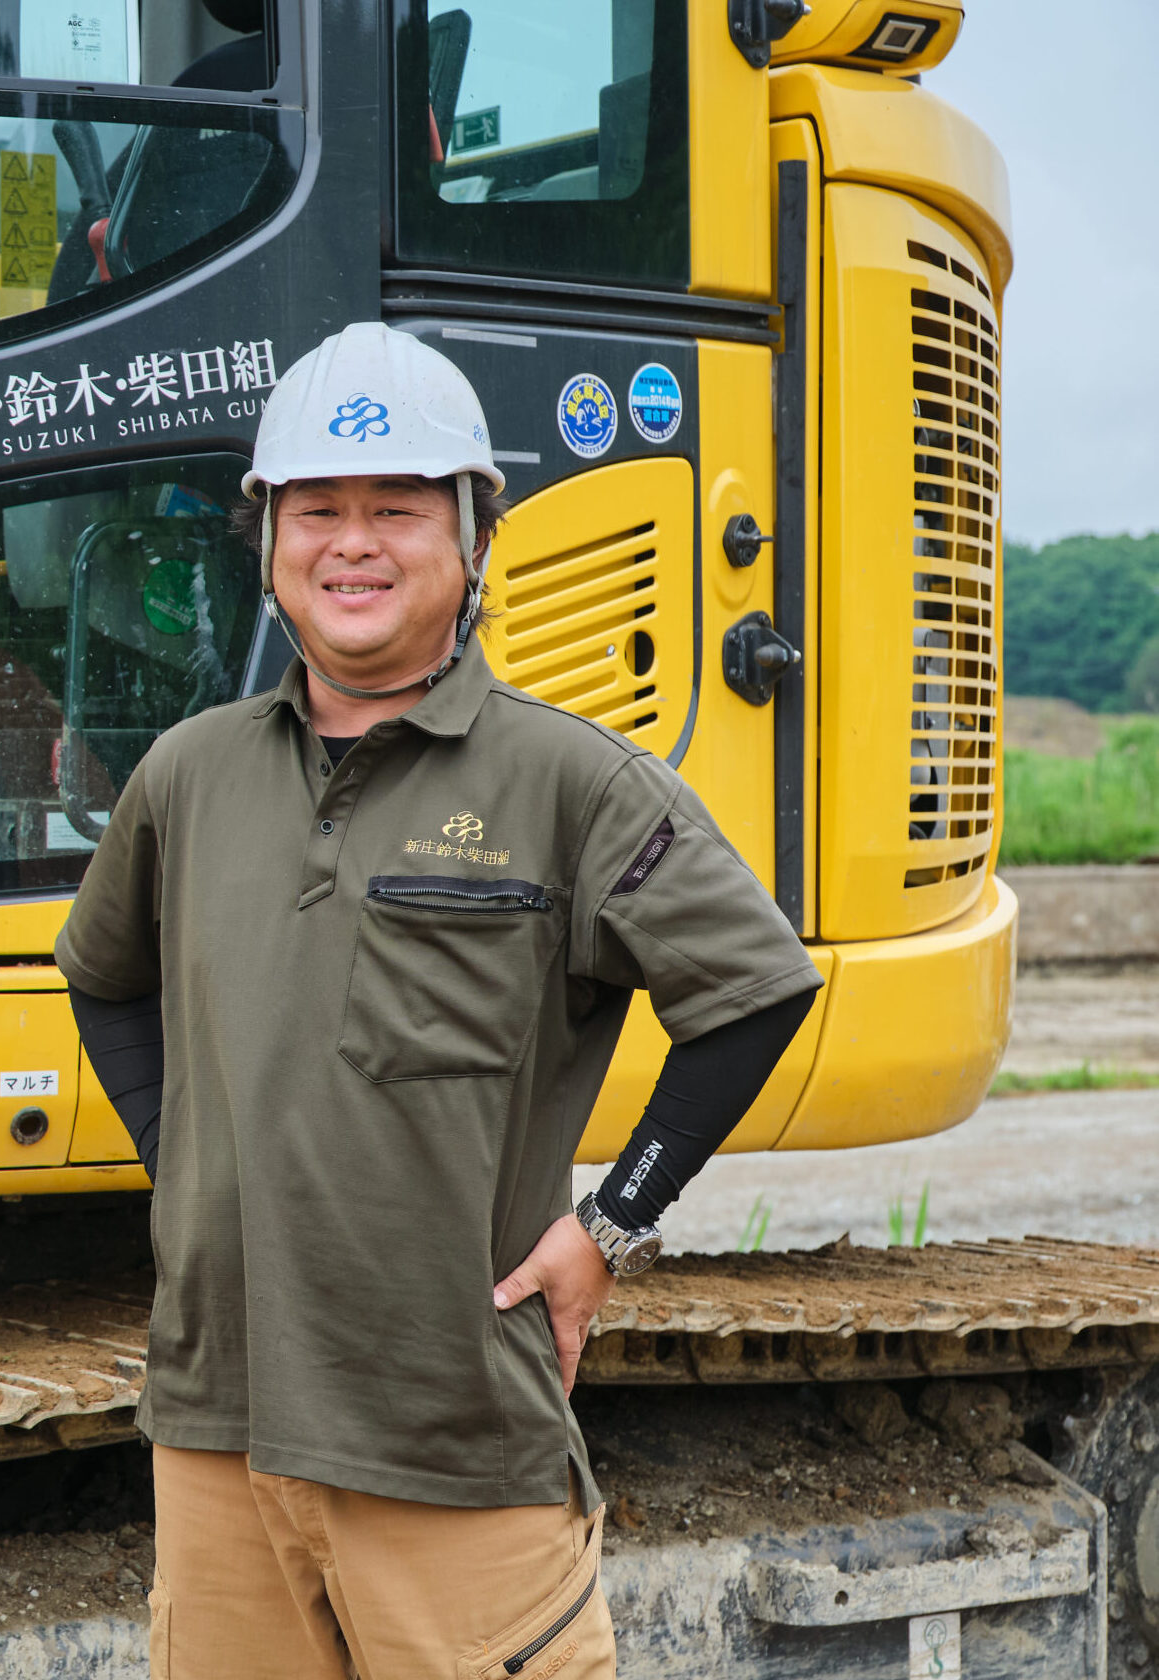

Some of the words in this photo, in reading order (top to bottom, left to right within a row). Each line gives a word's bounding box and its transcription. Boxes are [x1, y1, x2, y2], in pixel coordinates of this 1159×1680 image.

[2, 424, 97, 455] SUZUKI
[118, 406, 215, 437] SHIBATA
[403, 838, 511, 866] 新庄鈴木柴田組
[633, 838, 665, 879] TSDESIGN
[4, 1075, 54, 1090] マルチ
[619, 1139, 664, 1201] TSDESIGN
[529, 1639, 580, 1680] DESIGN
